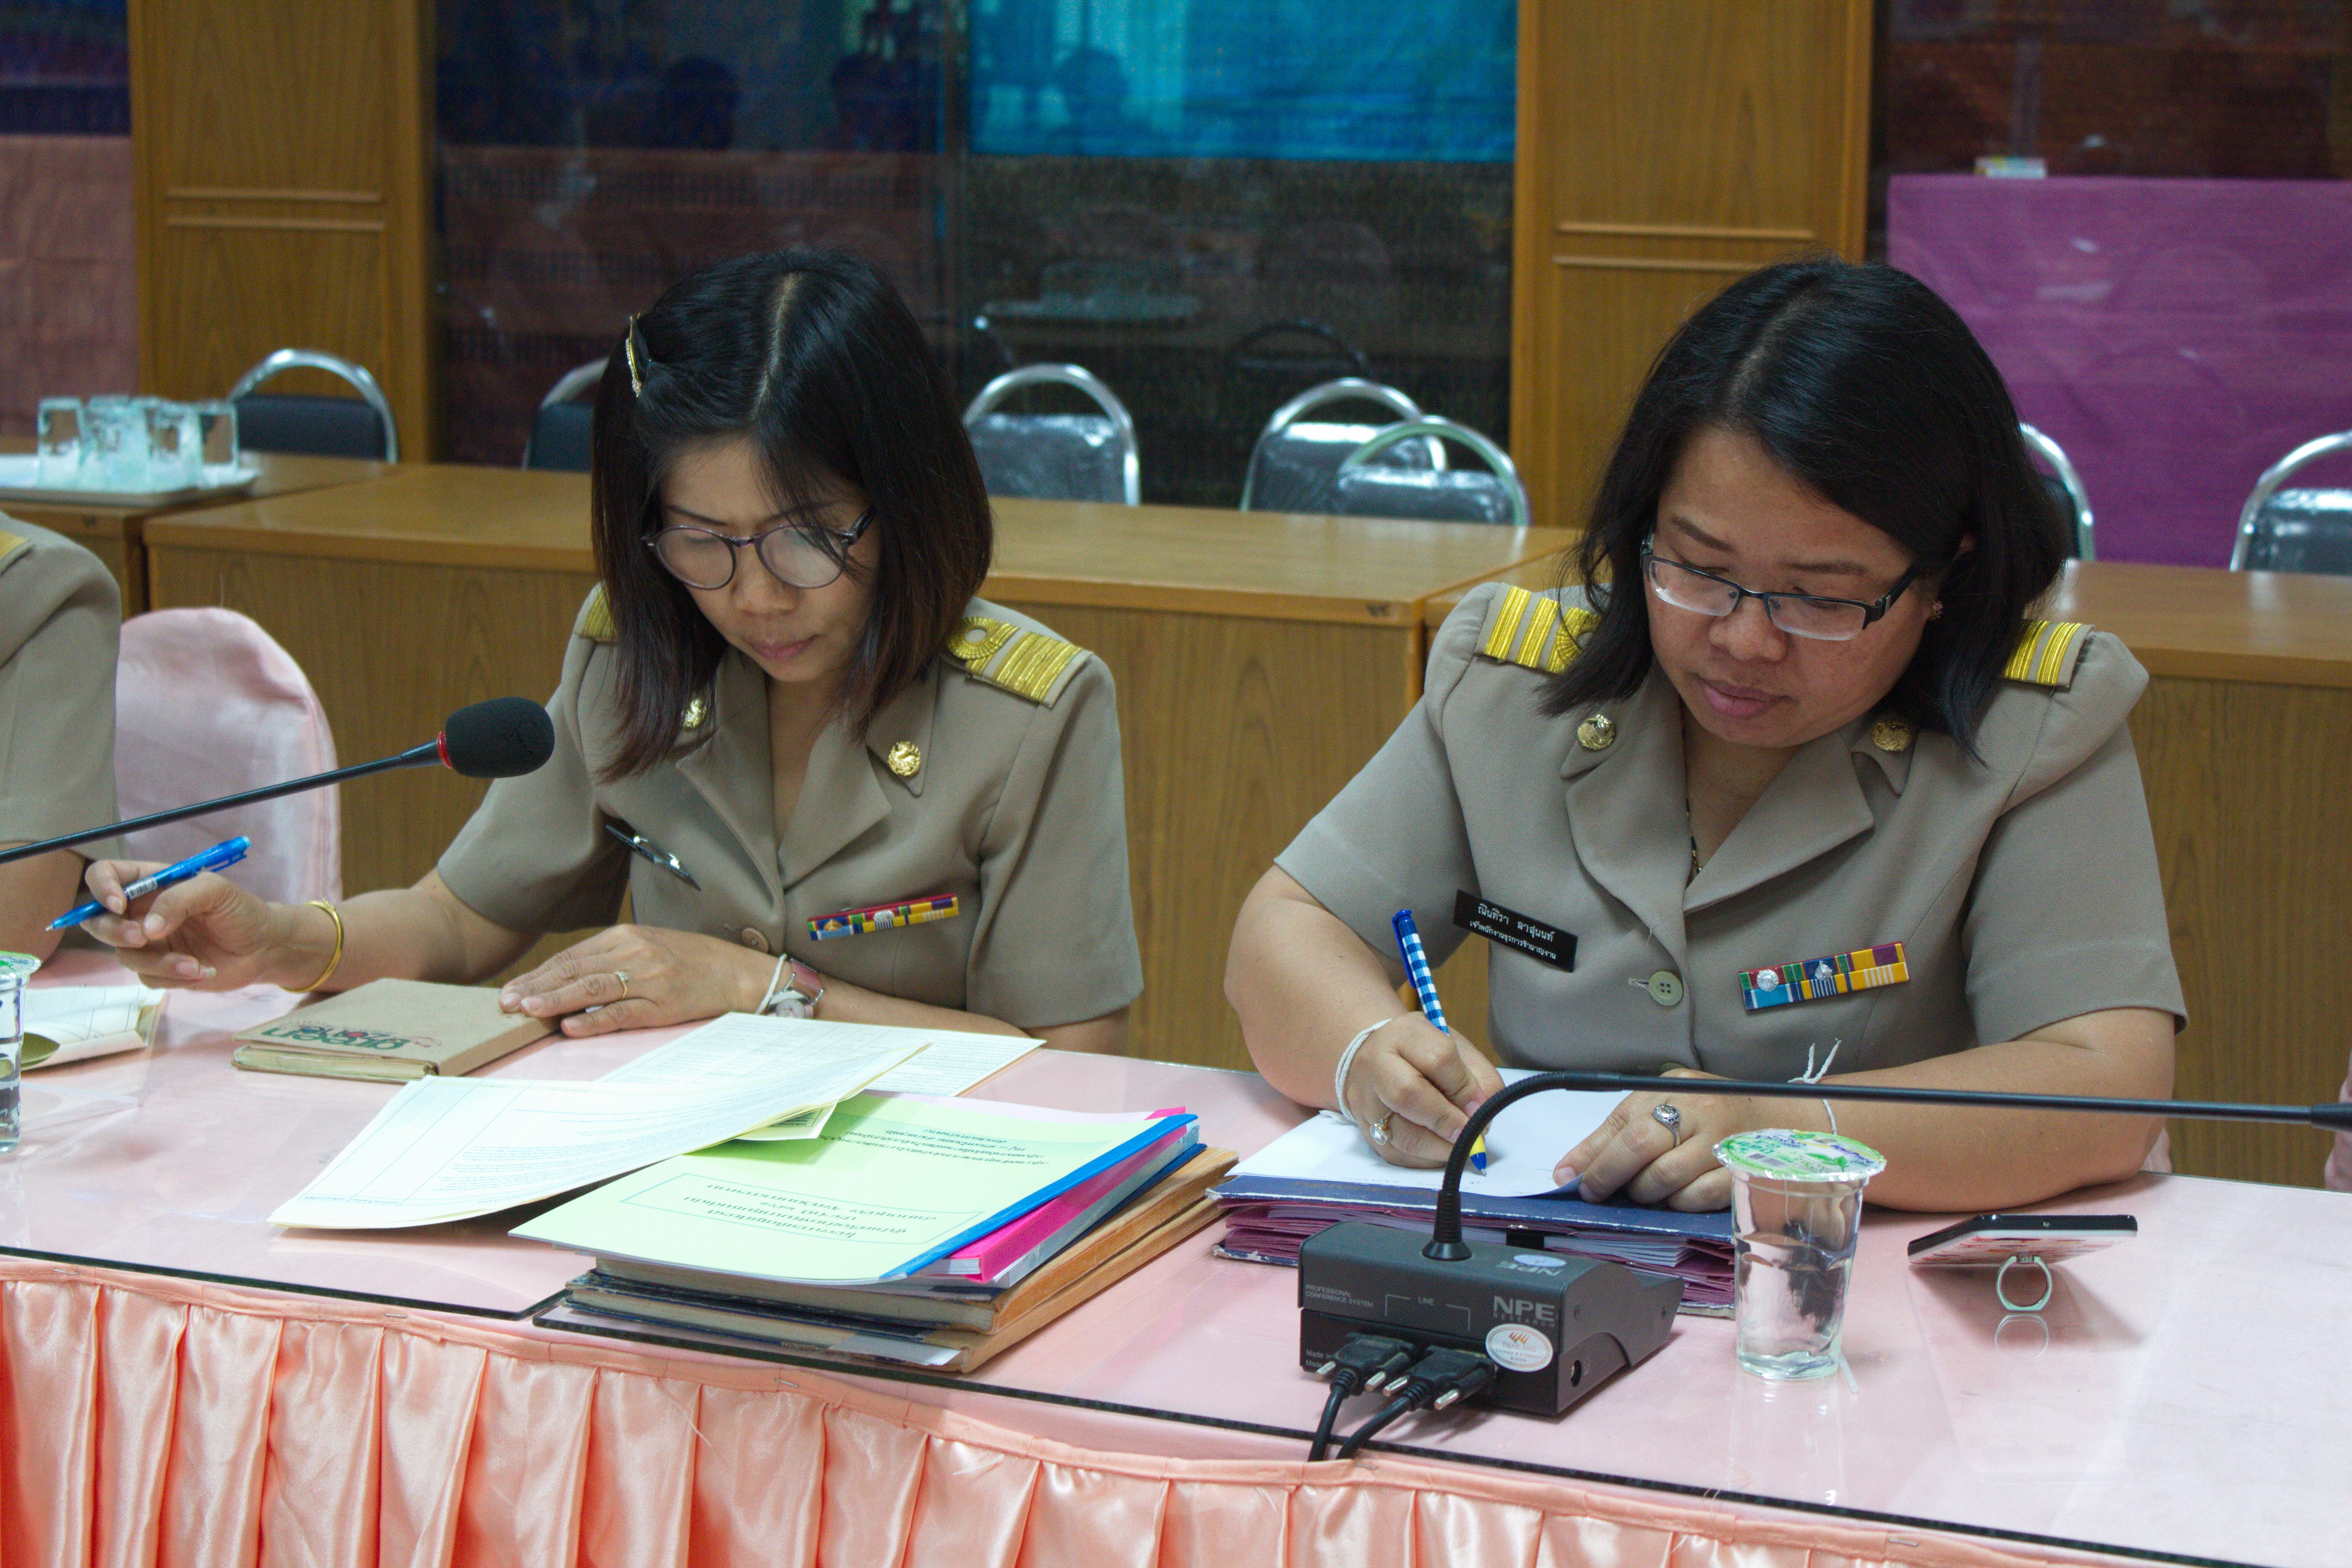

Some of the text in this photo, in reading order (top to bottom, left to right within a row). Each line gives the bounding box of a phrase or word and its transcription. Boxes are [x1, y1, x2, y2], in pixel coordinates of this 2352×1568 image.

[1305, 1284, 1351, 1297] PROFESSIONAL
[1305, 1291, 1373, 1308] CONFERENCE SYSTEM
[1418, 1296, 1435, 1306] LINE
[1493, 1295, 1555, 1322] NPE
[1305, 1349, 1324, 1359] Made
